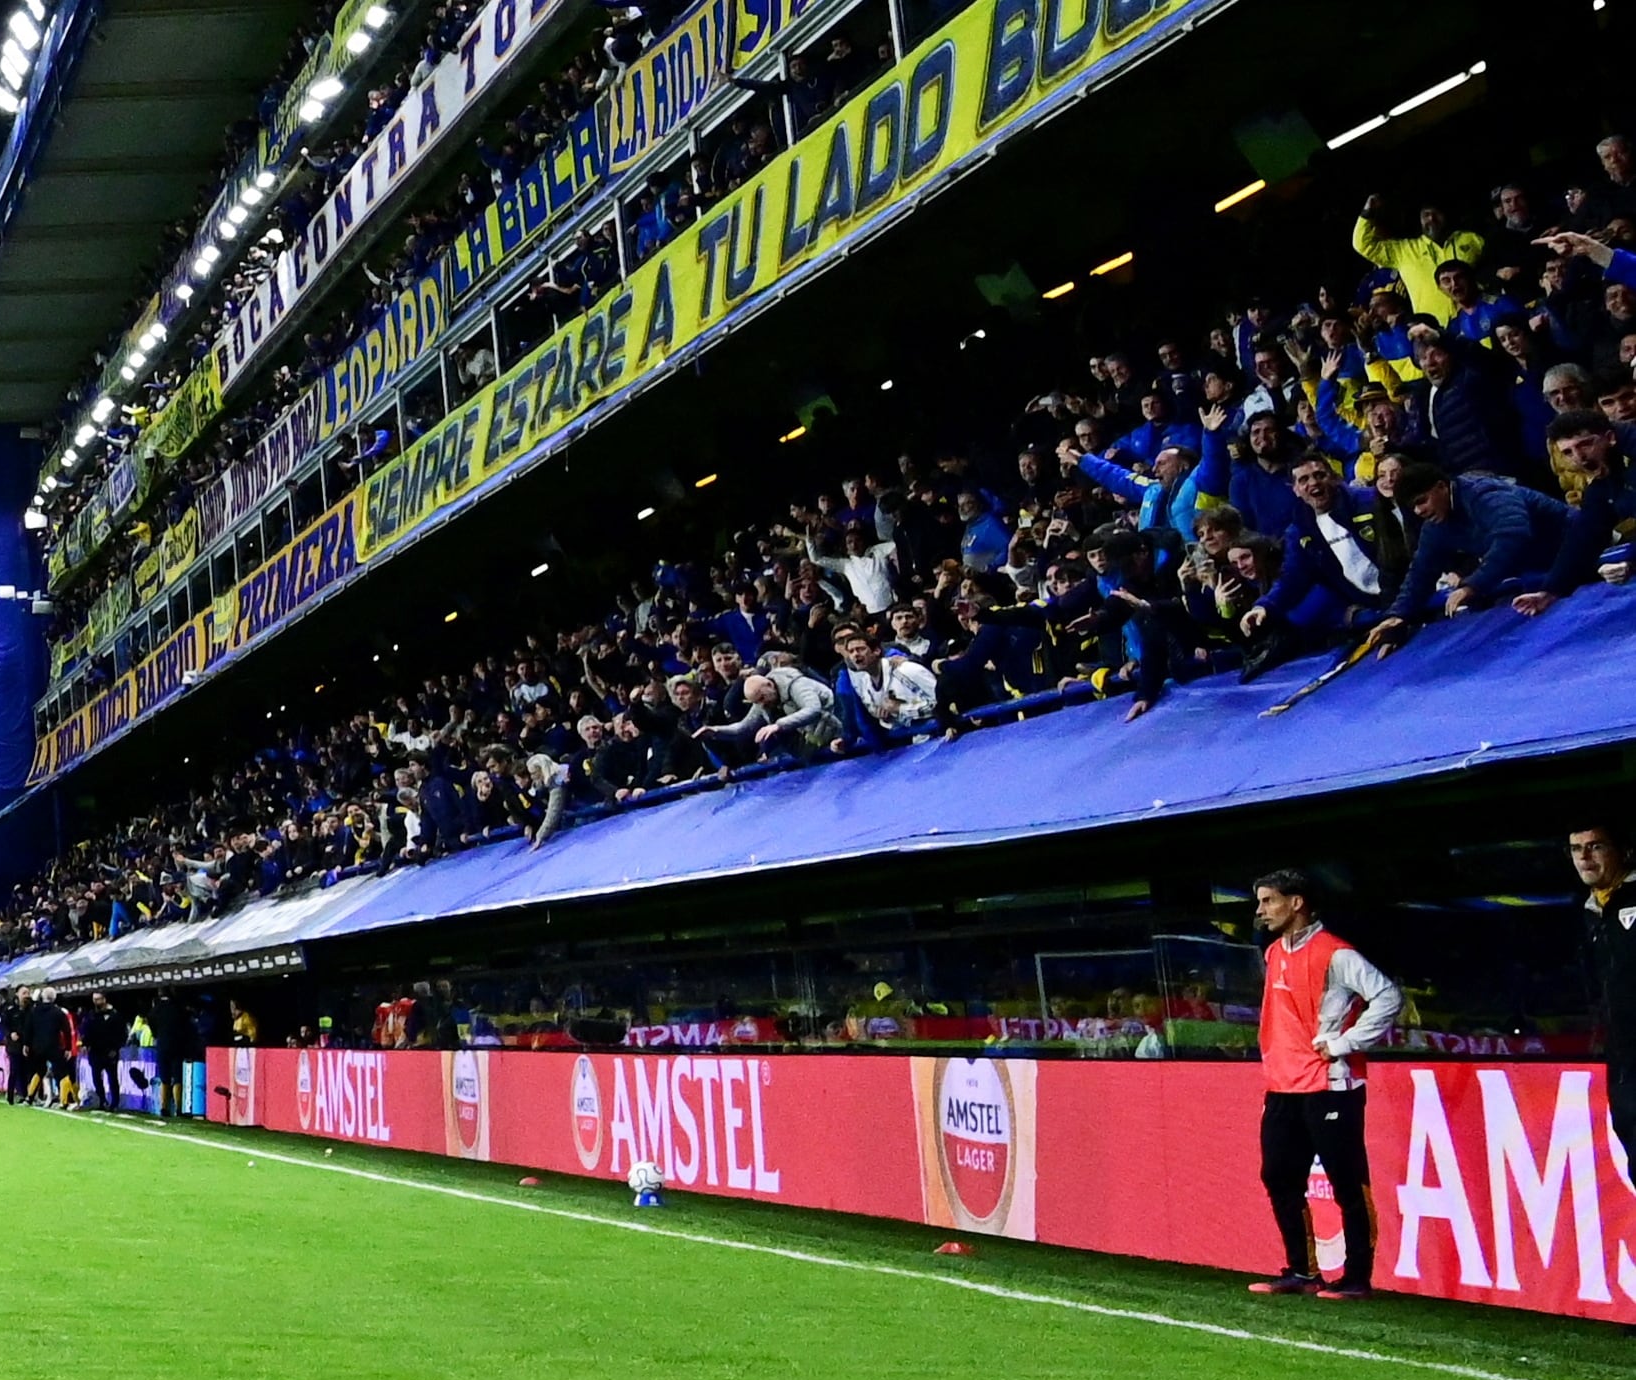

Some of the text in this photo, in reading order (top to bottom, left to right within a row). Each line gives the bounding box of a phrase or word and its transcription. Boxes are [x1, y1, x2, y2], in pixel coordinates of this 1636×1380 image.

[293, 82, 440, 290] CONTRA
[612, 72, 645, 165] LA
[450, 110, 601, 300] LA BOCA
[367, 401, 481, 551] SIEMPRE
[484, 289, 634, 468] ESTARE
[638, 262, 676, 367] A
[697, 184, 765, 322] TU
[779, 39, 957, 272] LADO
[135, 624, 196, 716] BARRIO
[232, 501, 364, 648] PRIMERA
[315, 1050, 391, 1141] AMSTEL
[610, 1055, 781, 1193] AMSTEL
[946, 1096, 1003, 1138] AMSTEL
[956, 1144, 995, 1173] LAGER
